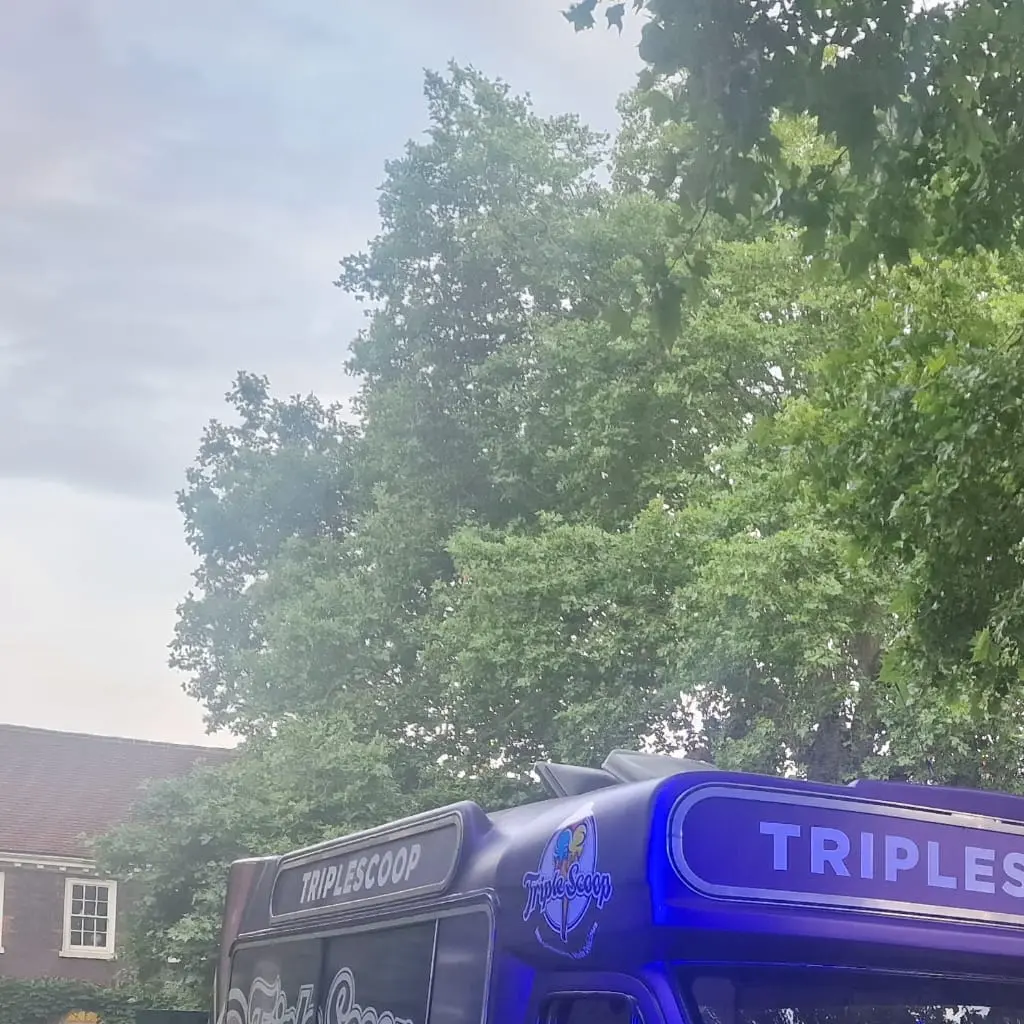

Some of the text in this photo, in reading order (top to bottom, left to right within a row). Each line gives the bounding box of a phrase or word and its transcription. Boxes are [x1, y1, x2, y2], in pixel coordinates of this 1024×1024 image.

[300, 843, 421, 903] TRIPLESCOOP
[522, 862, 613, 921] Triple Scoop
